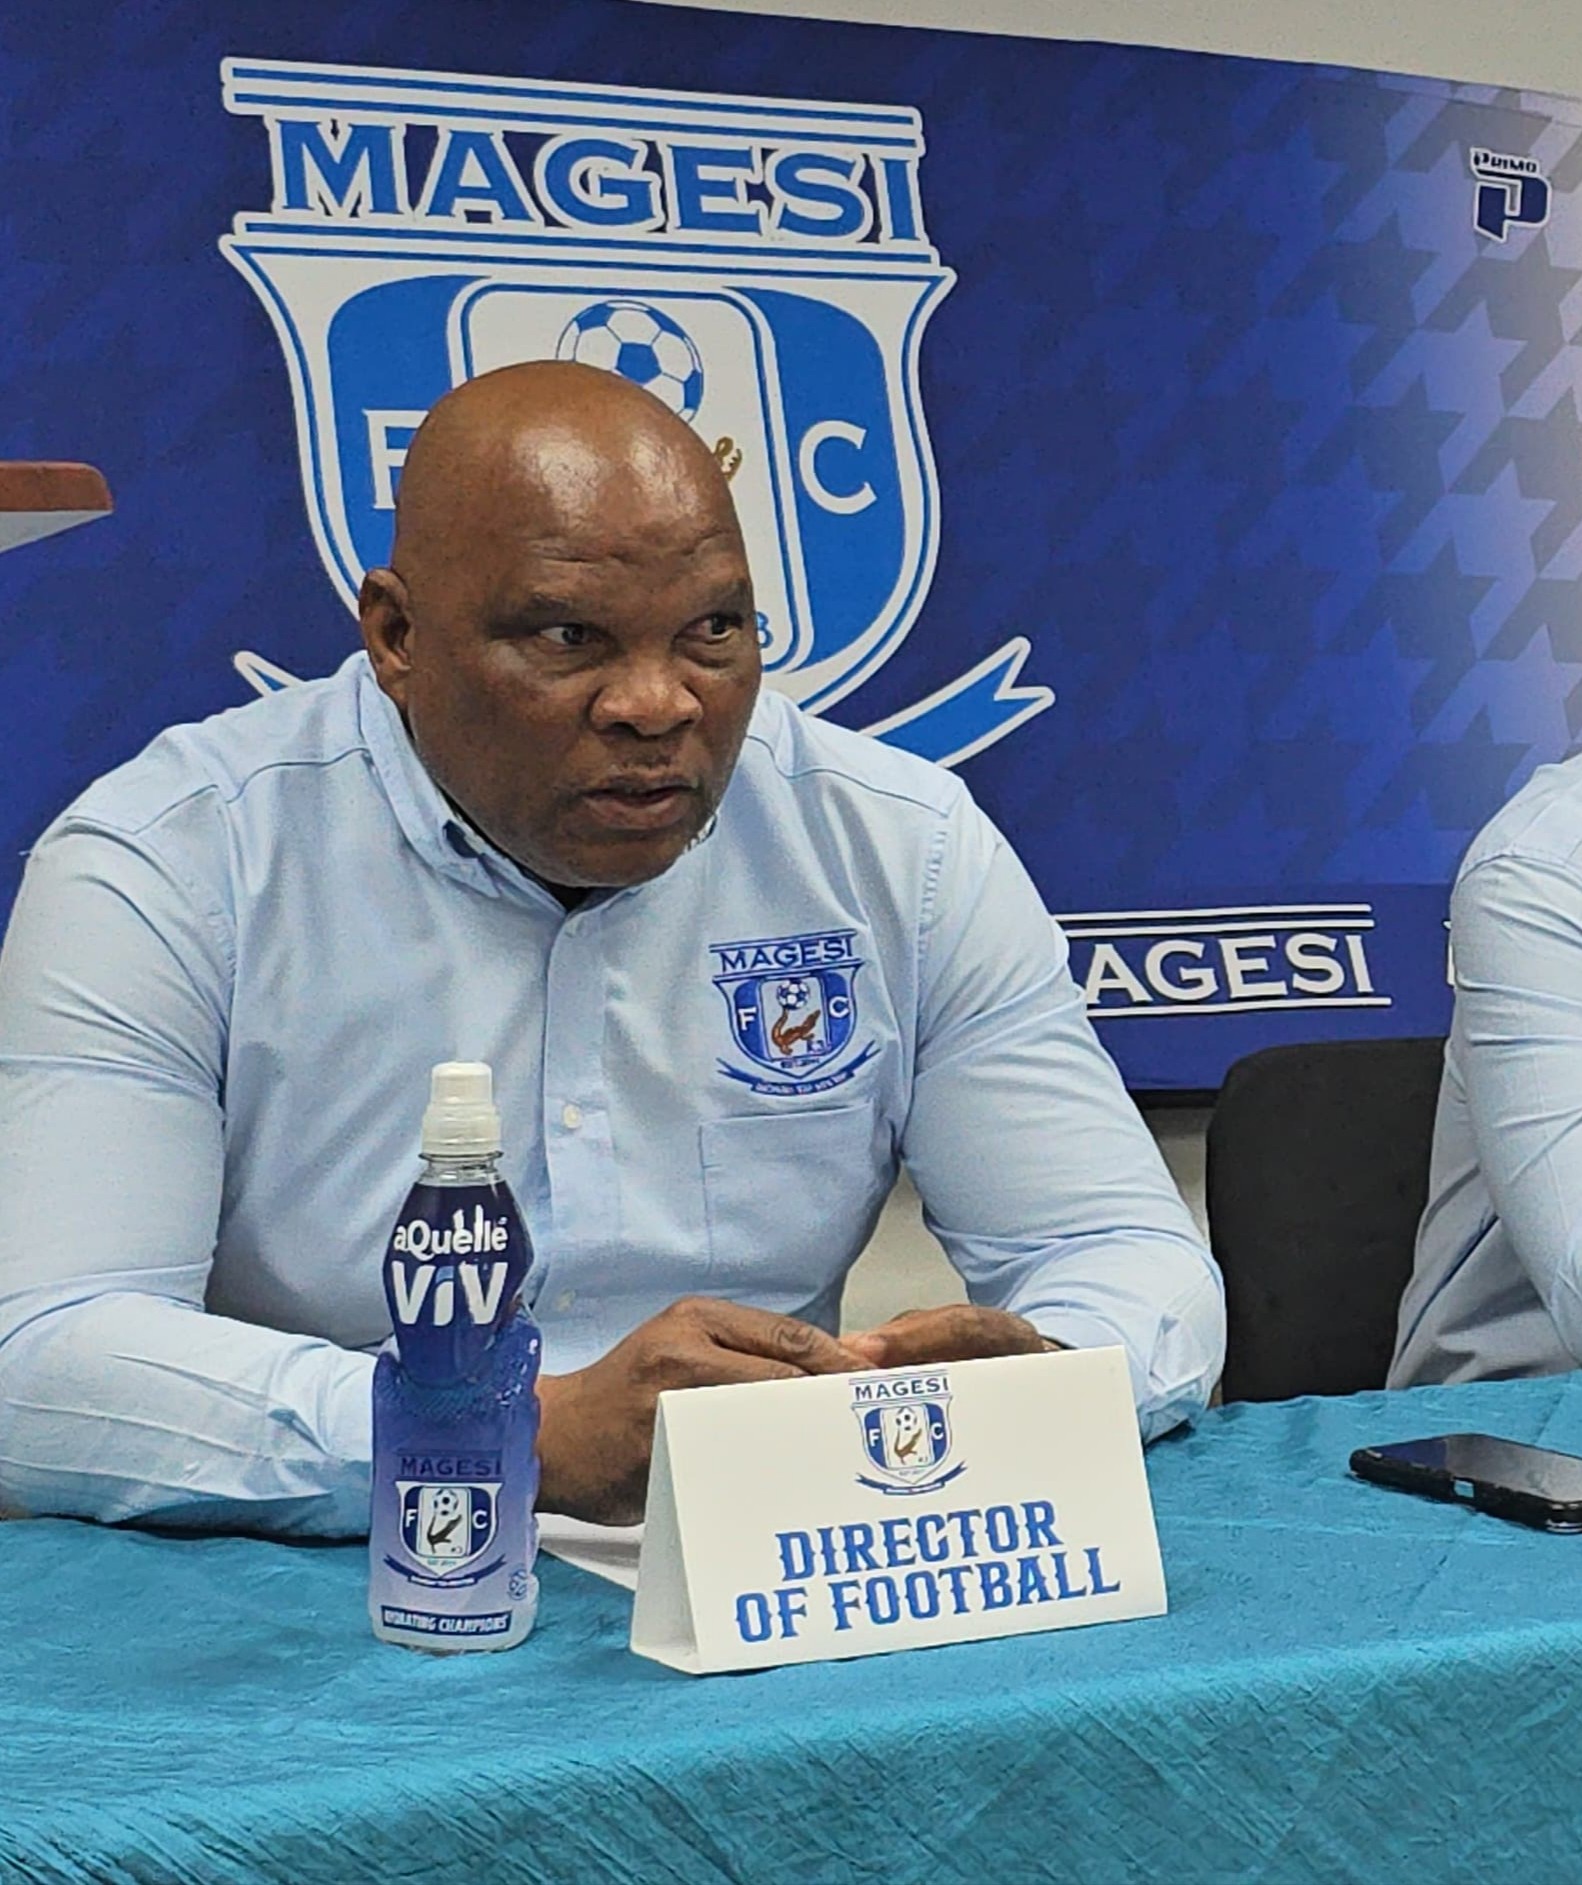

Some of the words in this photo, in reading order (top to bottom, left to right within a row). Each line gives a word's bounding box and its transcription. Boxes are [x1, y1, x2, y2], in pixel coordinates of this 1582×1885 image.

[273, 117, 924, 243] MAGESI
[1472, 150, 1539, 174] PRIMO
[361, 408, 430, 510] F
[799, 419, 878, 517] C
[719, 936, 853, 973] MAGESI
[1085, 932, 1375, 1003] AGESI
[737, 1007, 757, 1031] F
[829, 996, 851, 1019] C
[855, 1377, 949, 1402] MAGESI
[869, 1428, 881, 1447] F
[930, 1422, 944, 1440] C
[401, 1457, 503, 1477] MAGESI
[405, 1508, 418, 1528] F
[472, 1509, 489, 1529] C
[774, 1498, 1065, 1583] DIRECTOR
[734, 1586, 810, 1644] OF
[833, 1546, 1121, 1632] FOOTBALL
